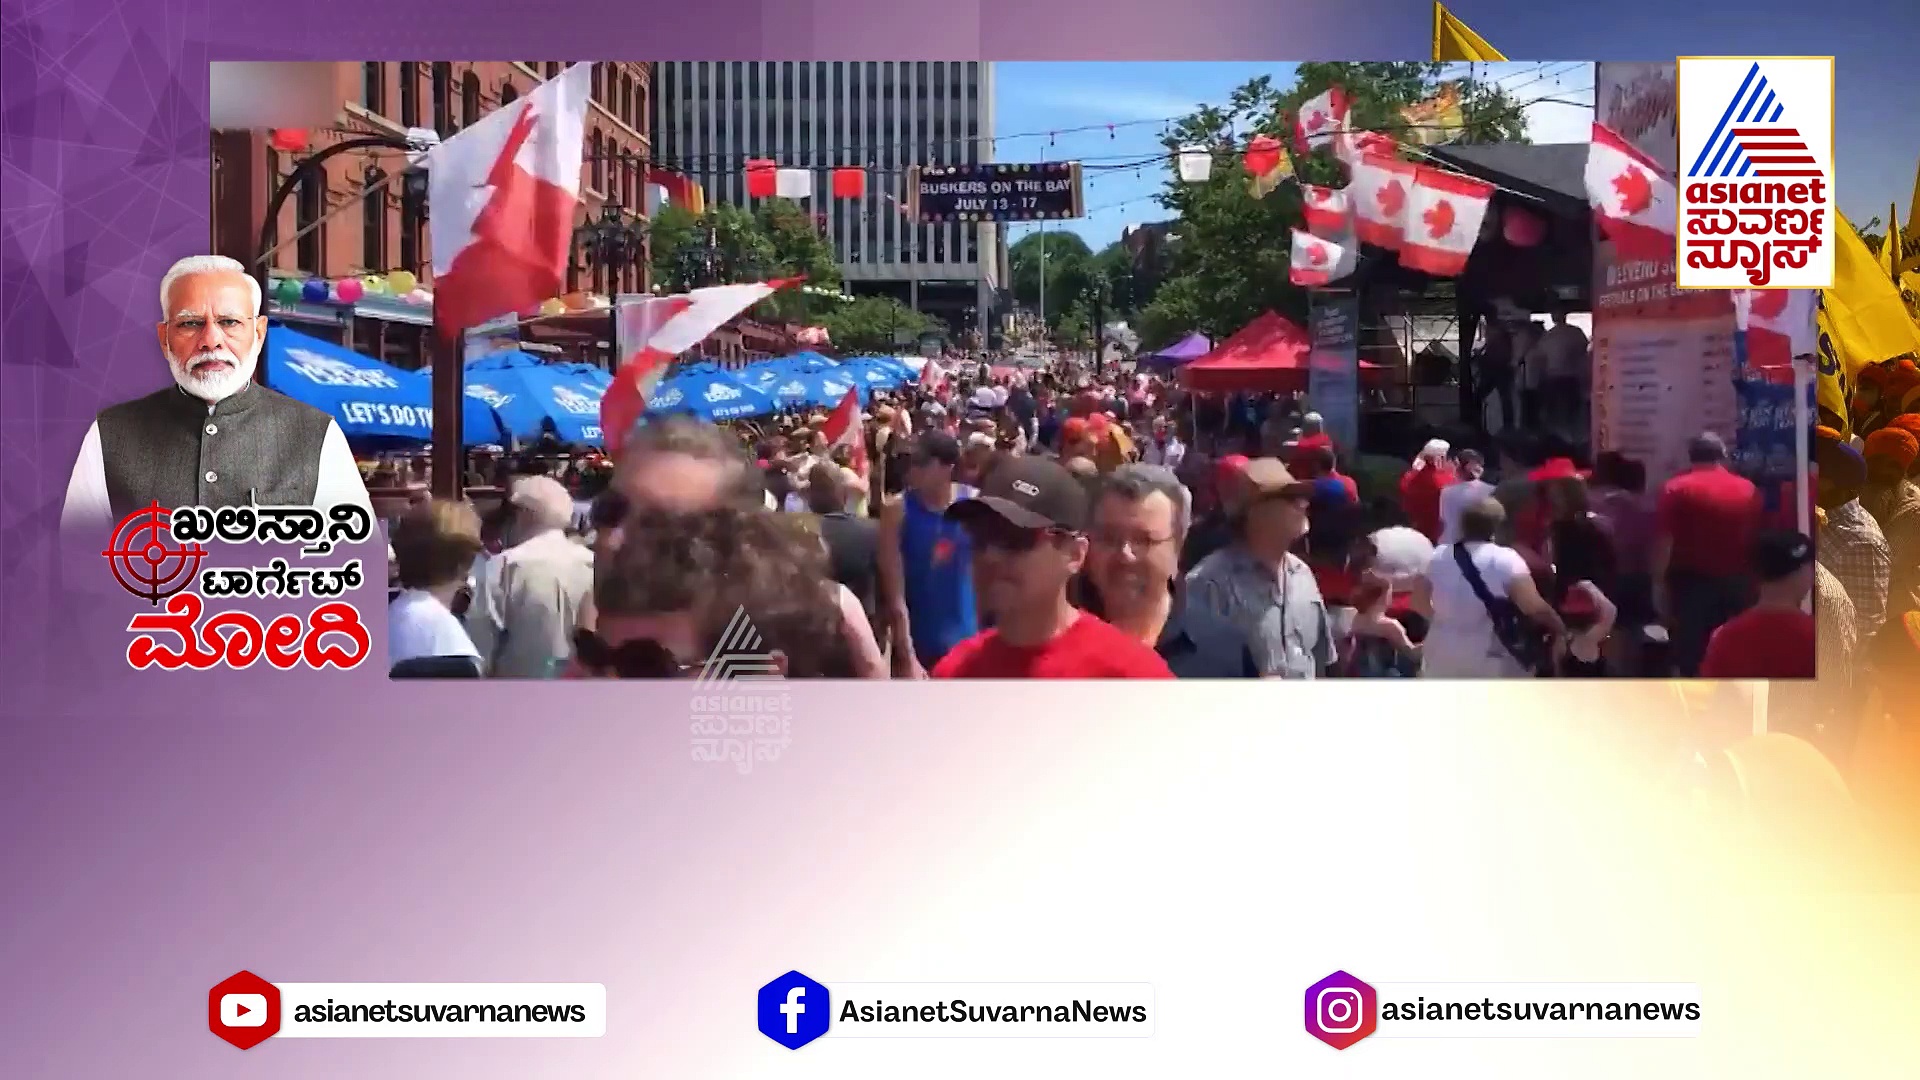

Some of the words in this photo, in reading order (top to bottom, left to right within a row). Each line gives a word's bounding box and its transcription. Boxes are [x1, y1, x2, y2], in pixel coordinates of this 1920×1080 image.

[920, 181, 987, 194] BUSKERS
[990, 180, 1012, 194] ON
[1016, 179, 1043, 192] THE
[1045, 179, 1072, 192] BAY
[954, 197, 988, 210] JULY
[993, 197, 1009, 210] 13
[1022, 196, 1038, 208] 17
[342, 402, 391, 425] LET'S
[389, 404, 416, 426] DO
